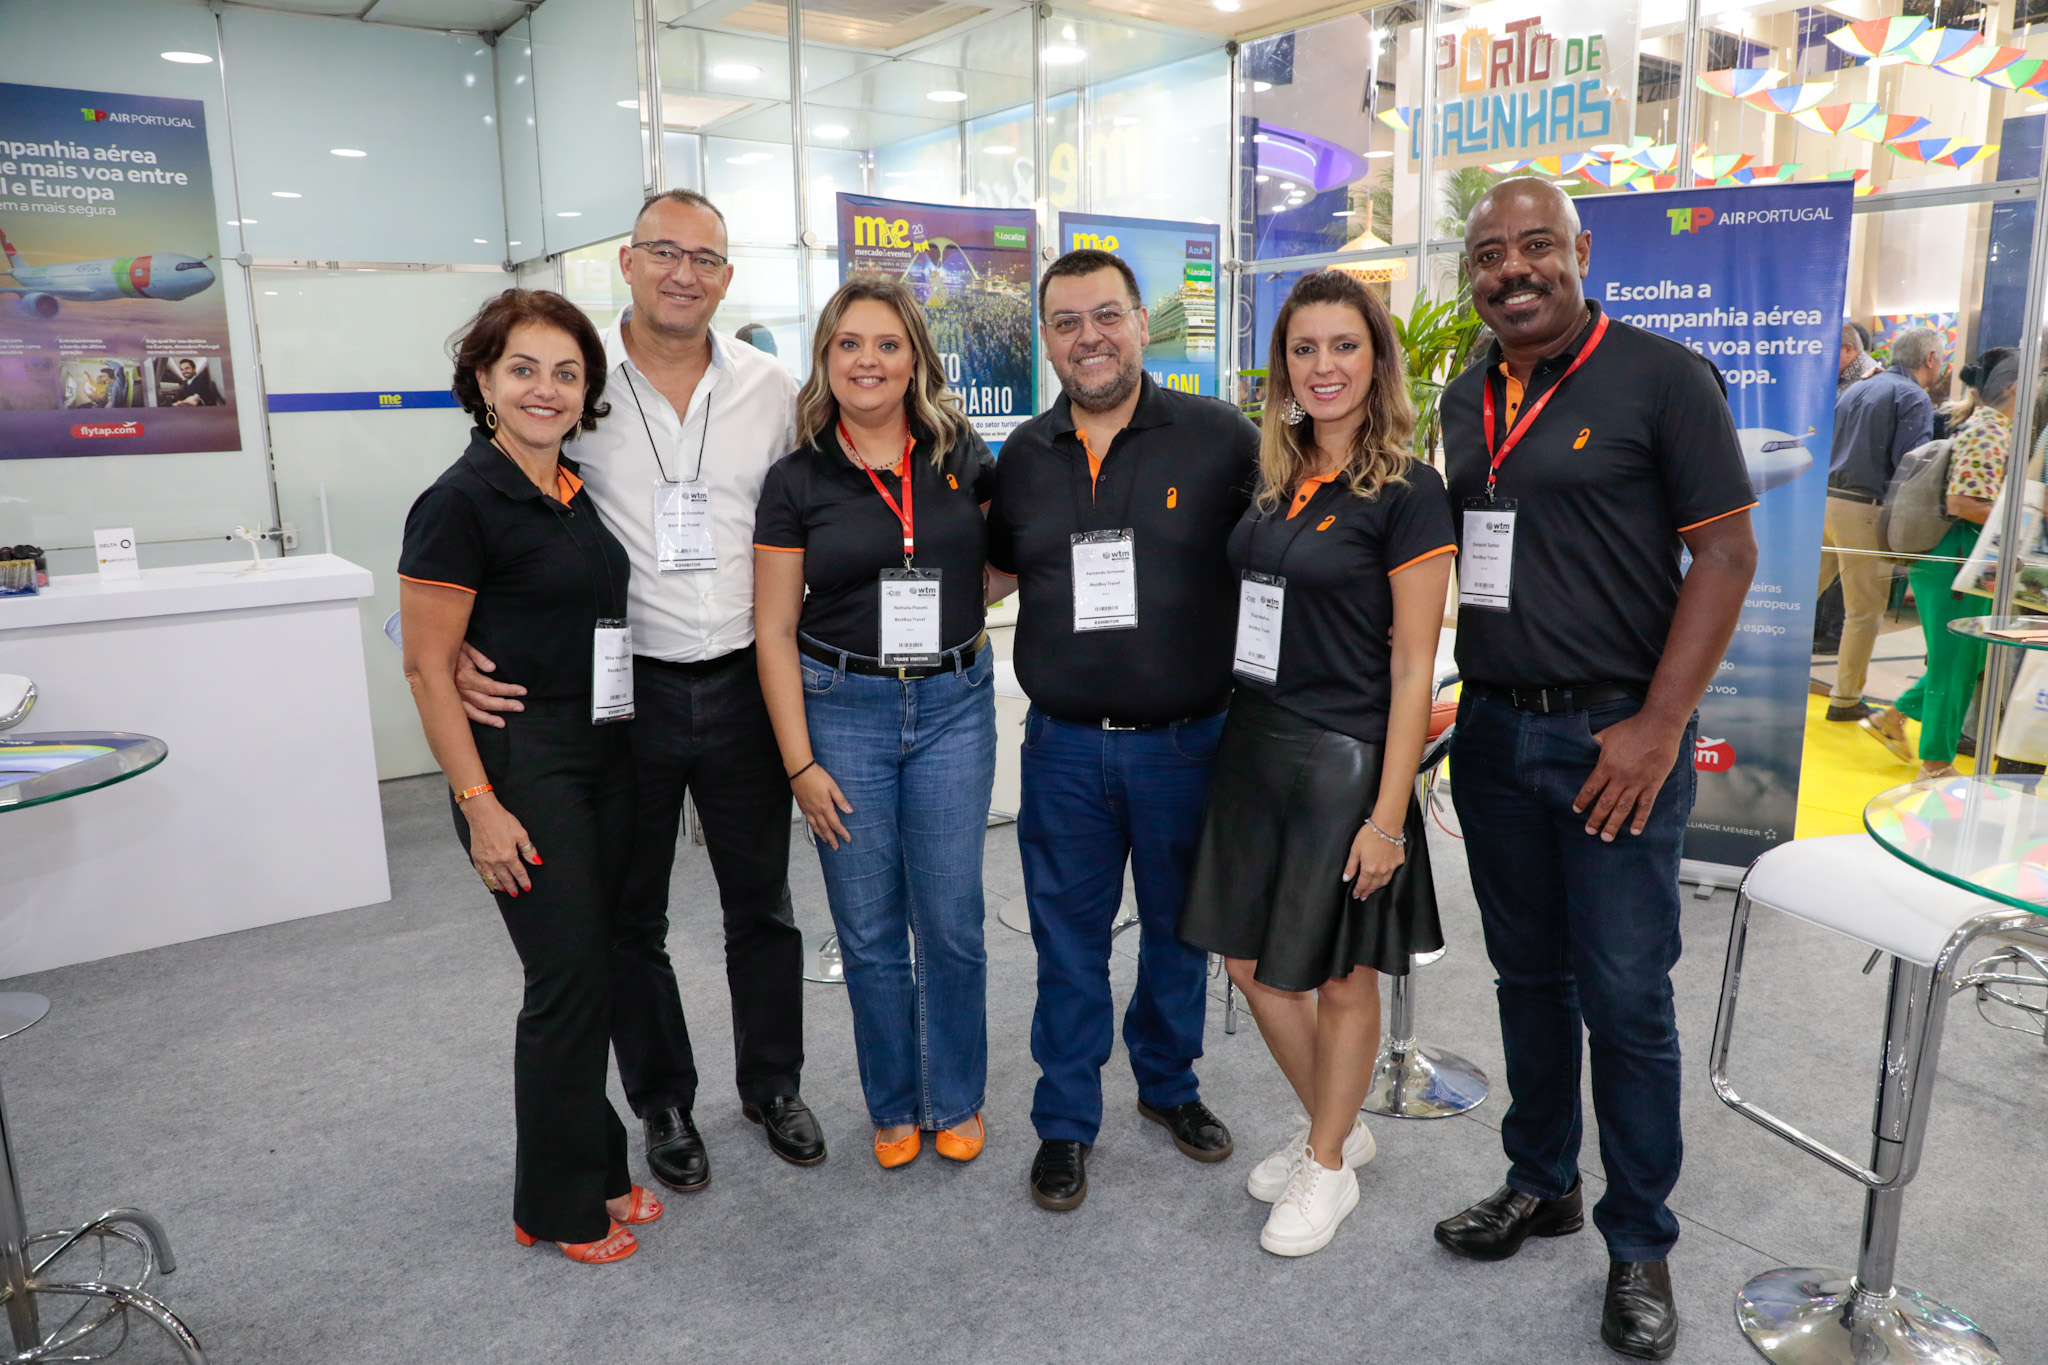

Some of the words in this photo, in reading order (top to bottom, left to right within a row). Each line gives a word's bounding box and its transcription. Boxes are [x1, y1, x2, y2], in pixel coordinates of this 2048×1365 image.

[1437, 16, 1559, 93] PORTO
[1565, 35, 1602, 76] DE
[81, 108, 107, 122] TAP
[94, 145, 157, 164] aérea
[0, 161, 17, 175] e
[21, 161, 78, 179] mais
[81, 167, 124, 182] voa
[128, 167, 188, 185] entre
[0, 177, 7, 195] l
[12, 182, 26, 196] e
[31, 179, 114, 203] Europa
[20, 202, 29, 212] a
[31, 202, 66, 213] mais
[68, 204, 116, 217] segura
[1666, 207, 1714, 235] TAP
[912, 224, 923, 235] 20
[1001, 232, 1025, 241] Localiza
[1188, 246, 1203, 255] Azul
[1190, 268, 1211, 277] Localiza
[1606, 280, 1693, 301] Escolha
[1698, 284, 1711, 298] a
[1753, 306, 1822, 326] aérea
[1708, 340, 1750, 355] voa
[1755, 336, 1823, 355] entre
[985, 420, 1000, 428] setor
[80, 426, 136, 438] flytap.com
[1493, 522, 1510, 530] wtm
[1266, 597, 1279, 606] wtm
[1744, 599, 1801, 611] europeus
[1743, 624, 1785, 636] espaço
[1719, 660, 1735, 670] do
[1715, 686, 1737, 694] voo
[1722, 826, 1760, 836] MEMBER
